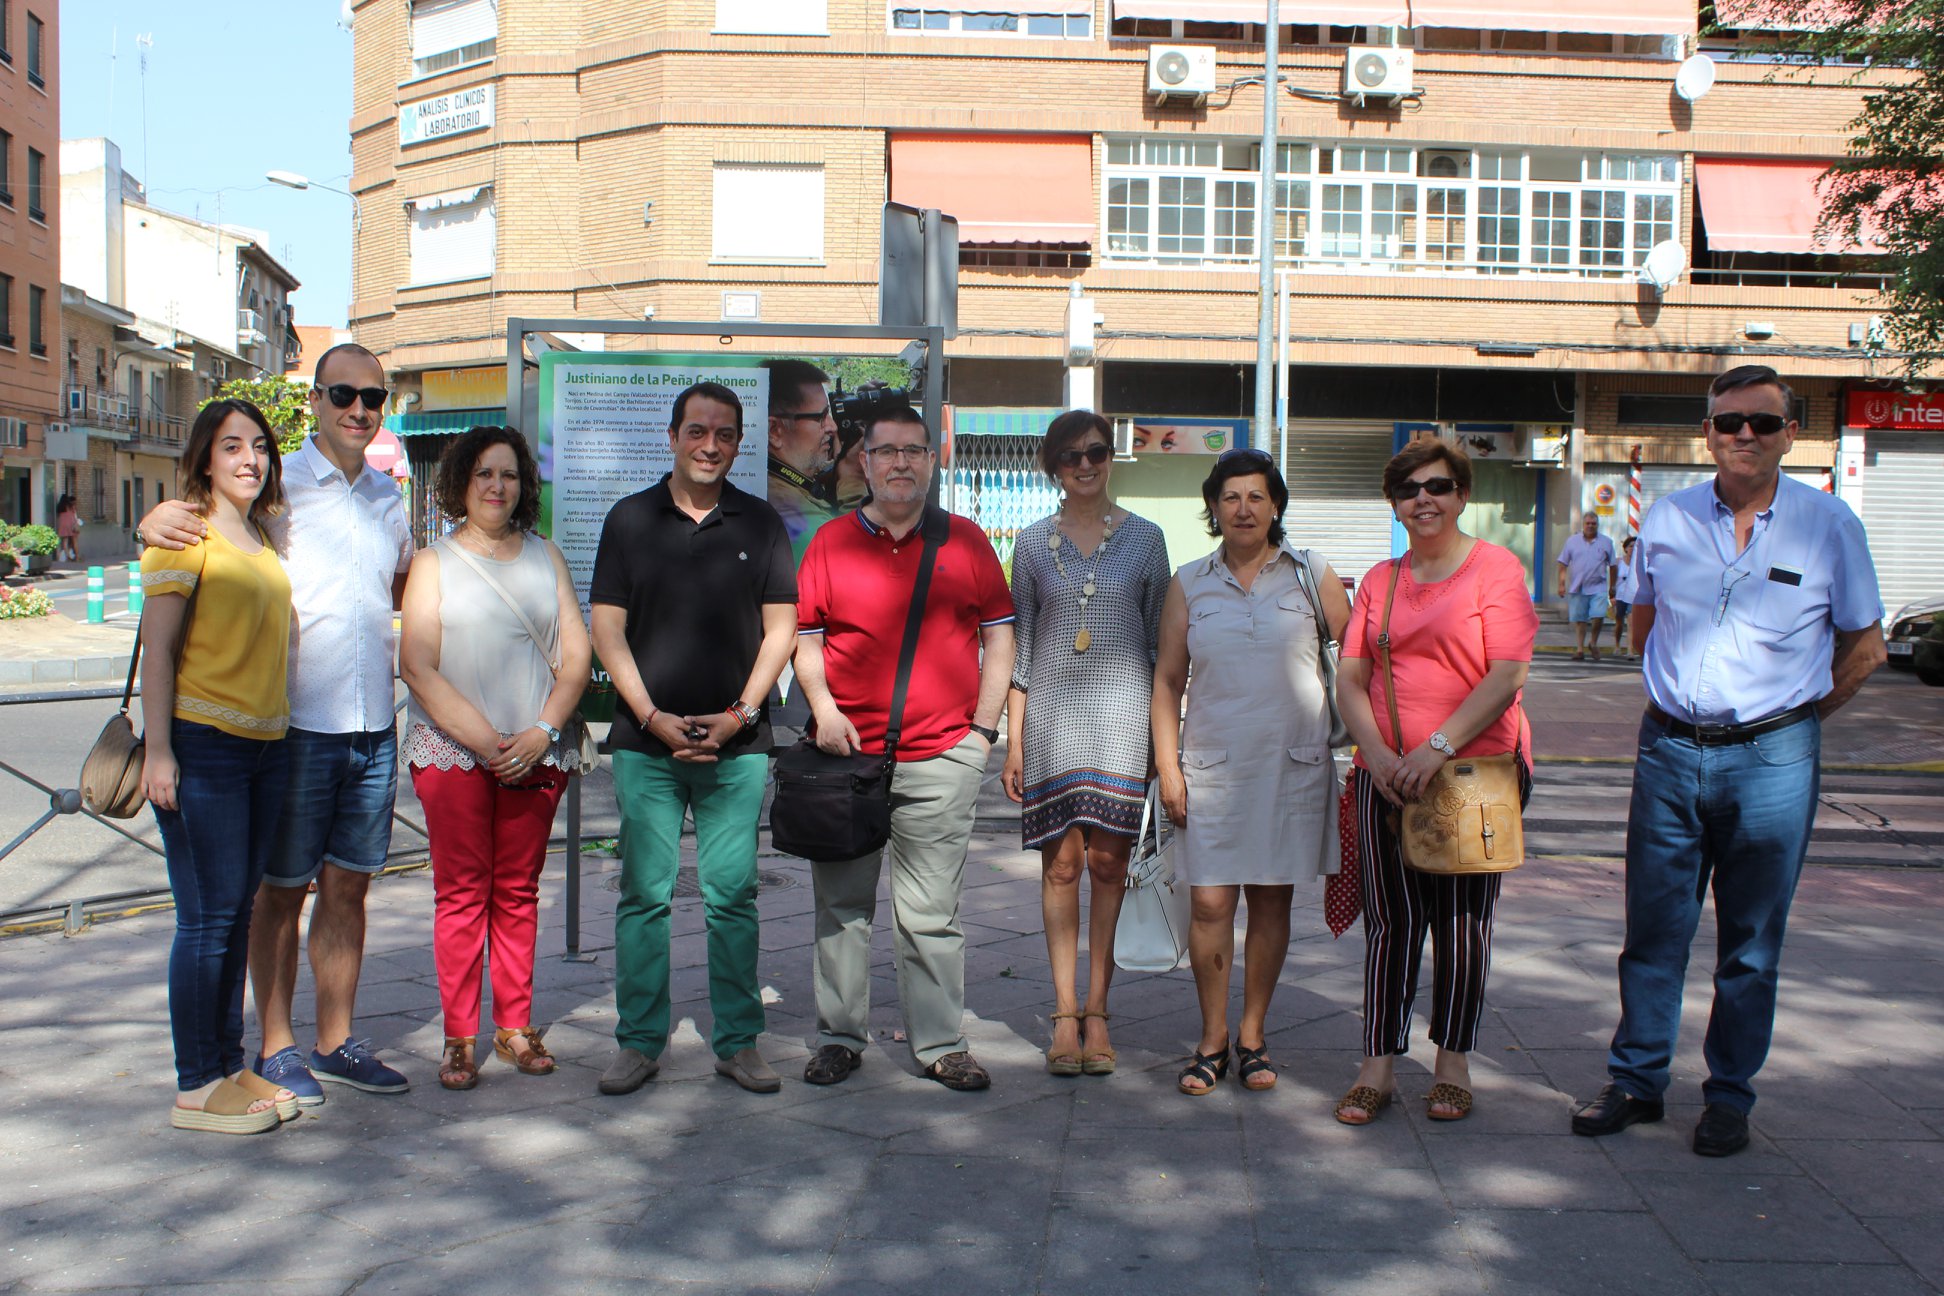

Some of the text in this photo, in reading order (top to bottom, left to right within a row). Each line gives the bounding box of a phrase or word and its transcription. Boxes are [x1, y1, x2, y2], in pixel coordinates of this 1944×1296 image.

[418, 88, 486, 118] ANALISIS CLINICOS
[424, 110, 480, 137] LABORATORIO
[432, 370, 507, 384] ALIMENTACIO
[565, 372, 627, 384] Justiniano
[630, 374, 644, 384] de
[648, 374, 659, 385] la
[662, 374, 692, 386] Peña
[1894, 402, 1944, 423] inte
[780, 467, 805, 485] Nikon
